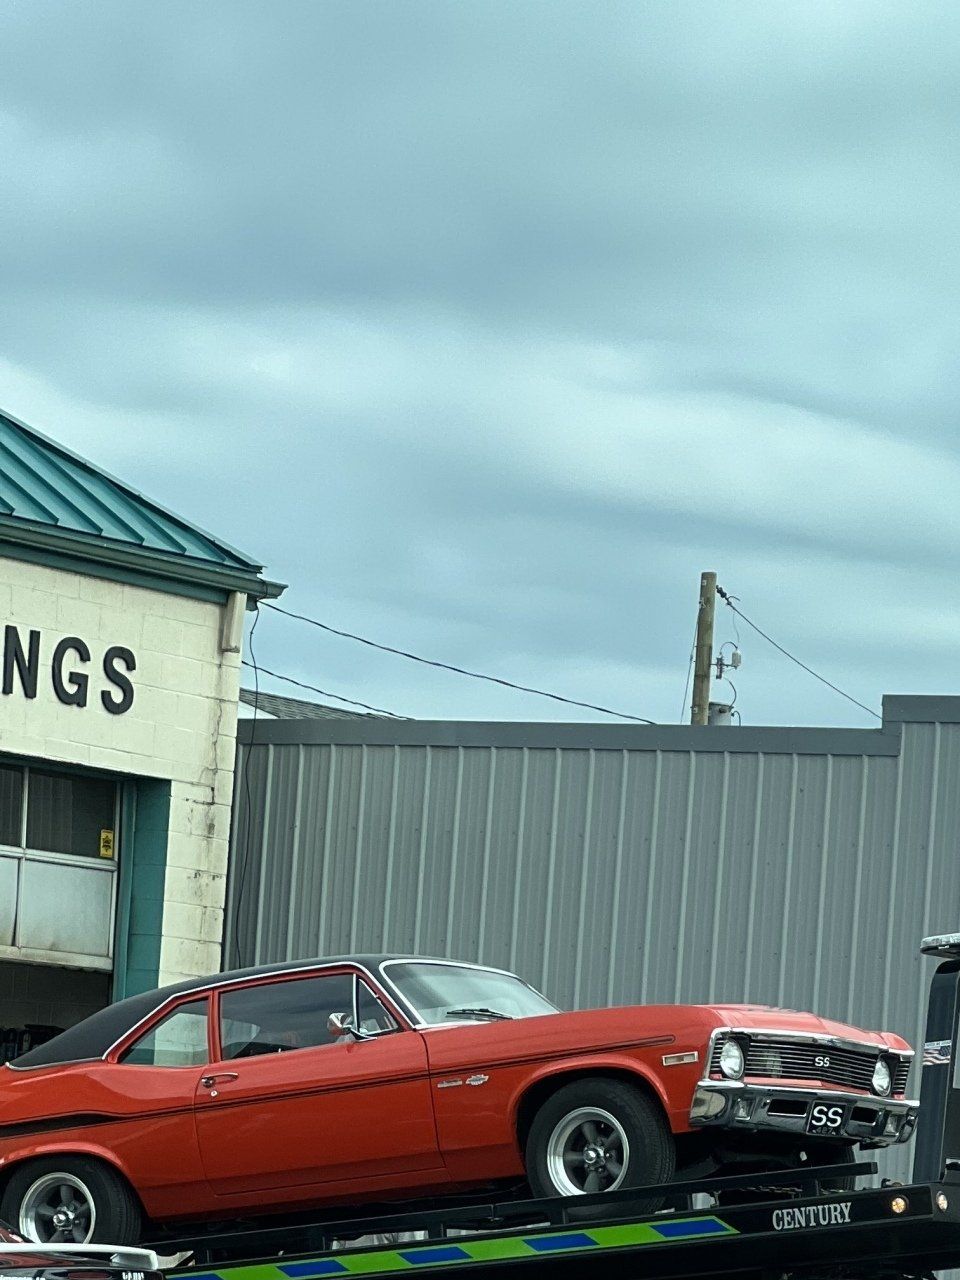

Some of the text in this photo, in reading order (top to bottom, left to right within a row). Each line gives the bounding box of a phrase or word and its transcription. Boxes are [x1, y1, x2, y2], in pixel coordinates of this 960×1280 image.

[815, 1056, 830, 1067] SS
[811, 1105, 843, 1127] SS
[772, 1202, 852, 1231] CENTURY
